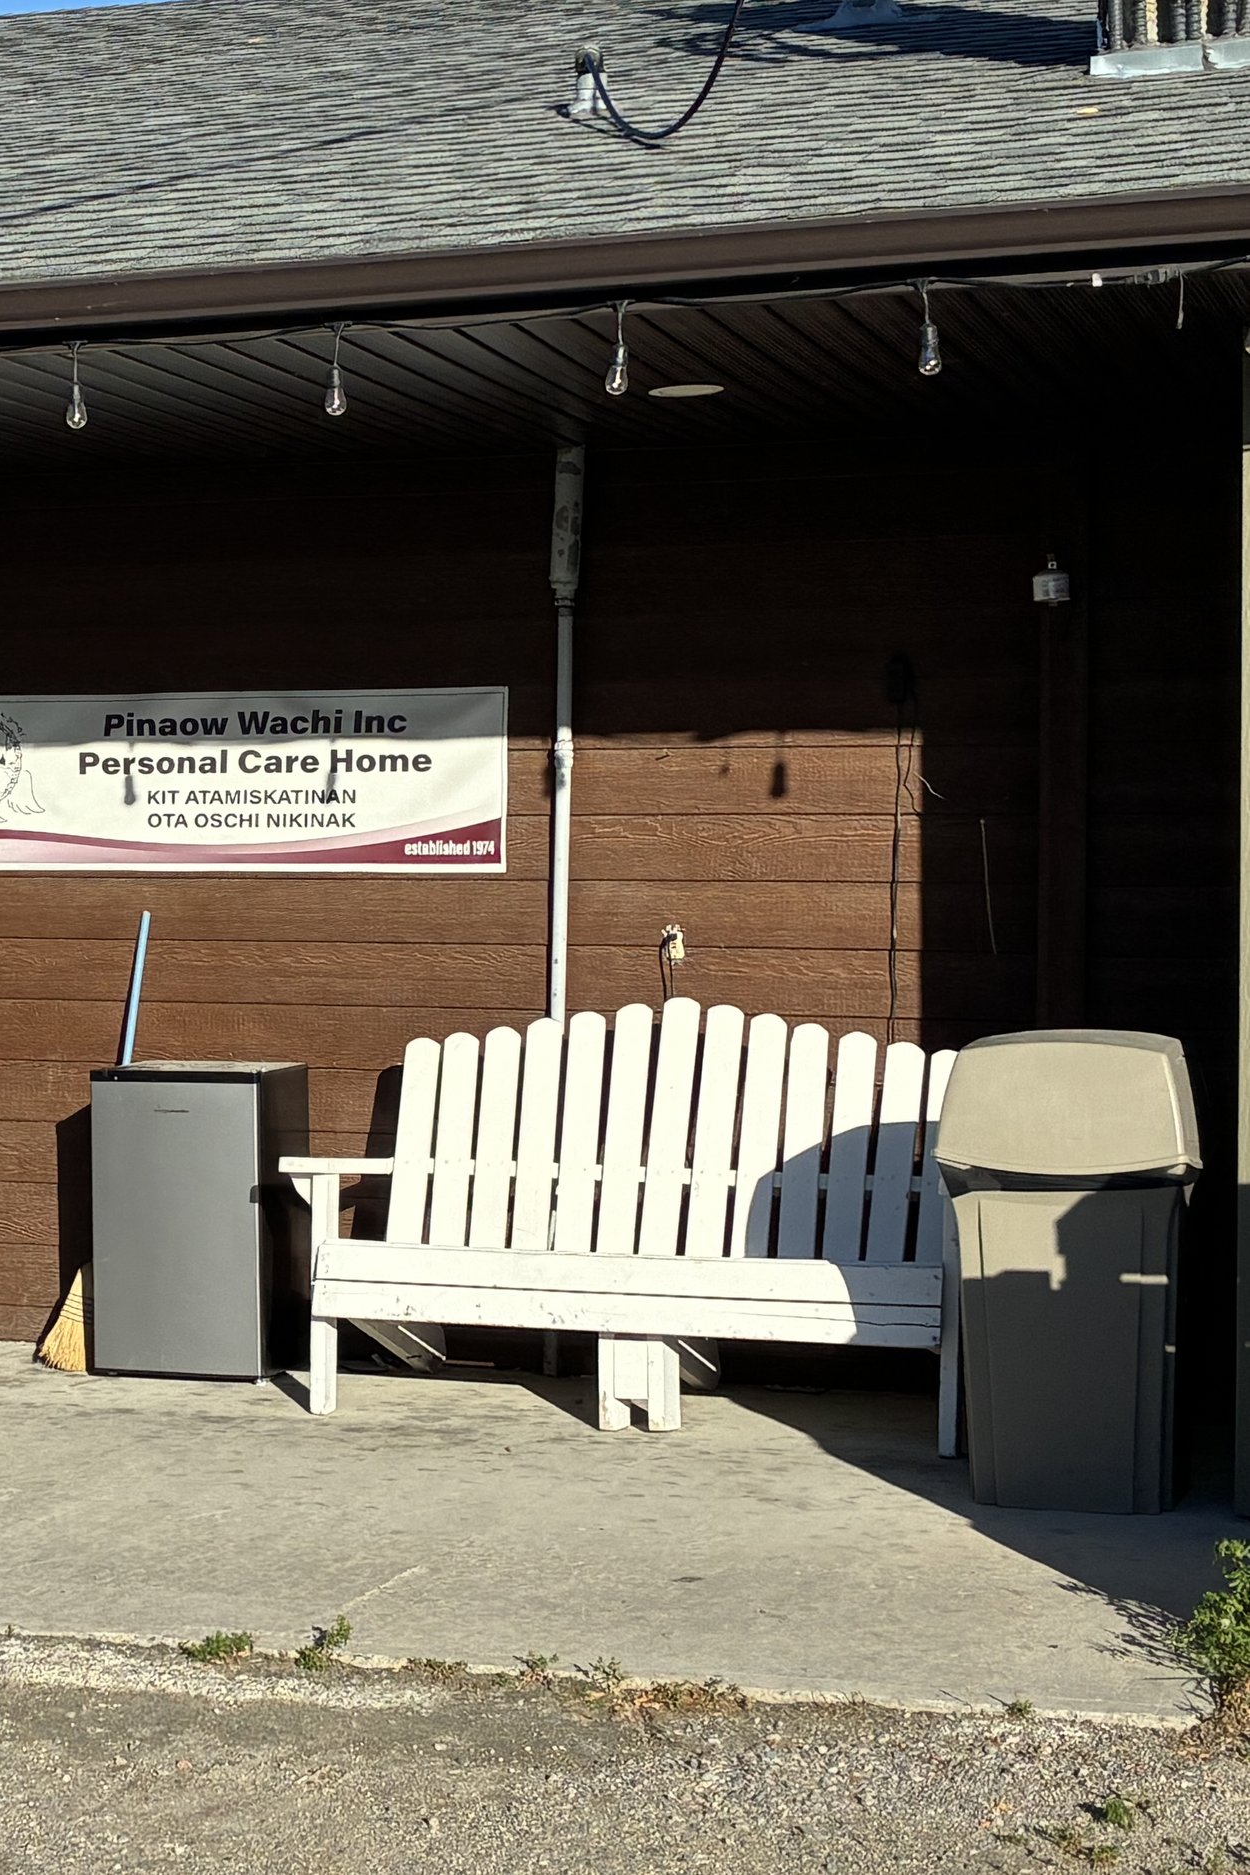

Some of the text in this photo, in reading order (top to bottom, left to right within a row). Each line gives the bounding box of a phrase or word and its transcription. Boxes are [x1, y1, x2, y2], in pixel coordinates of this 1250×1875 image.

[104, 710, 408, 736] Pinaow Wachi Inc
[79, 749, 433, 775] Personal Care Home
[148, 789, 357, 805] KIT ATAMISKATINAN
[148, 813, 356, 828] OTA OSCHI NIKINAK
[404, 840, 495, 855] established 1974
